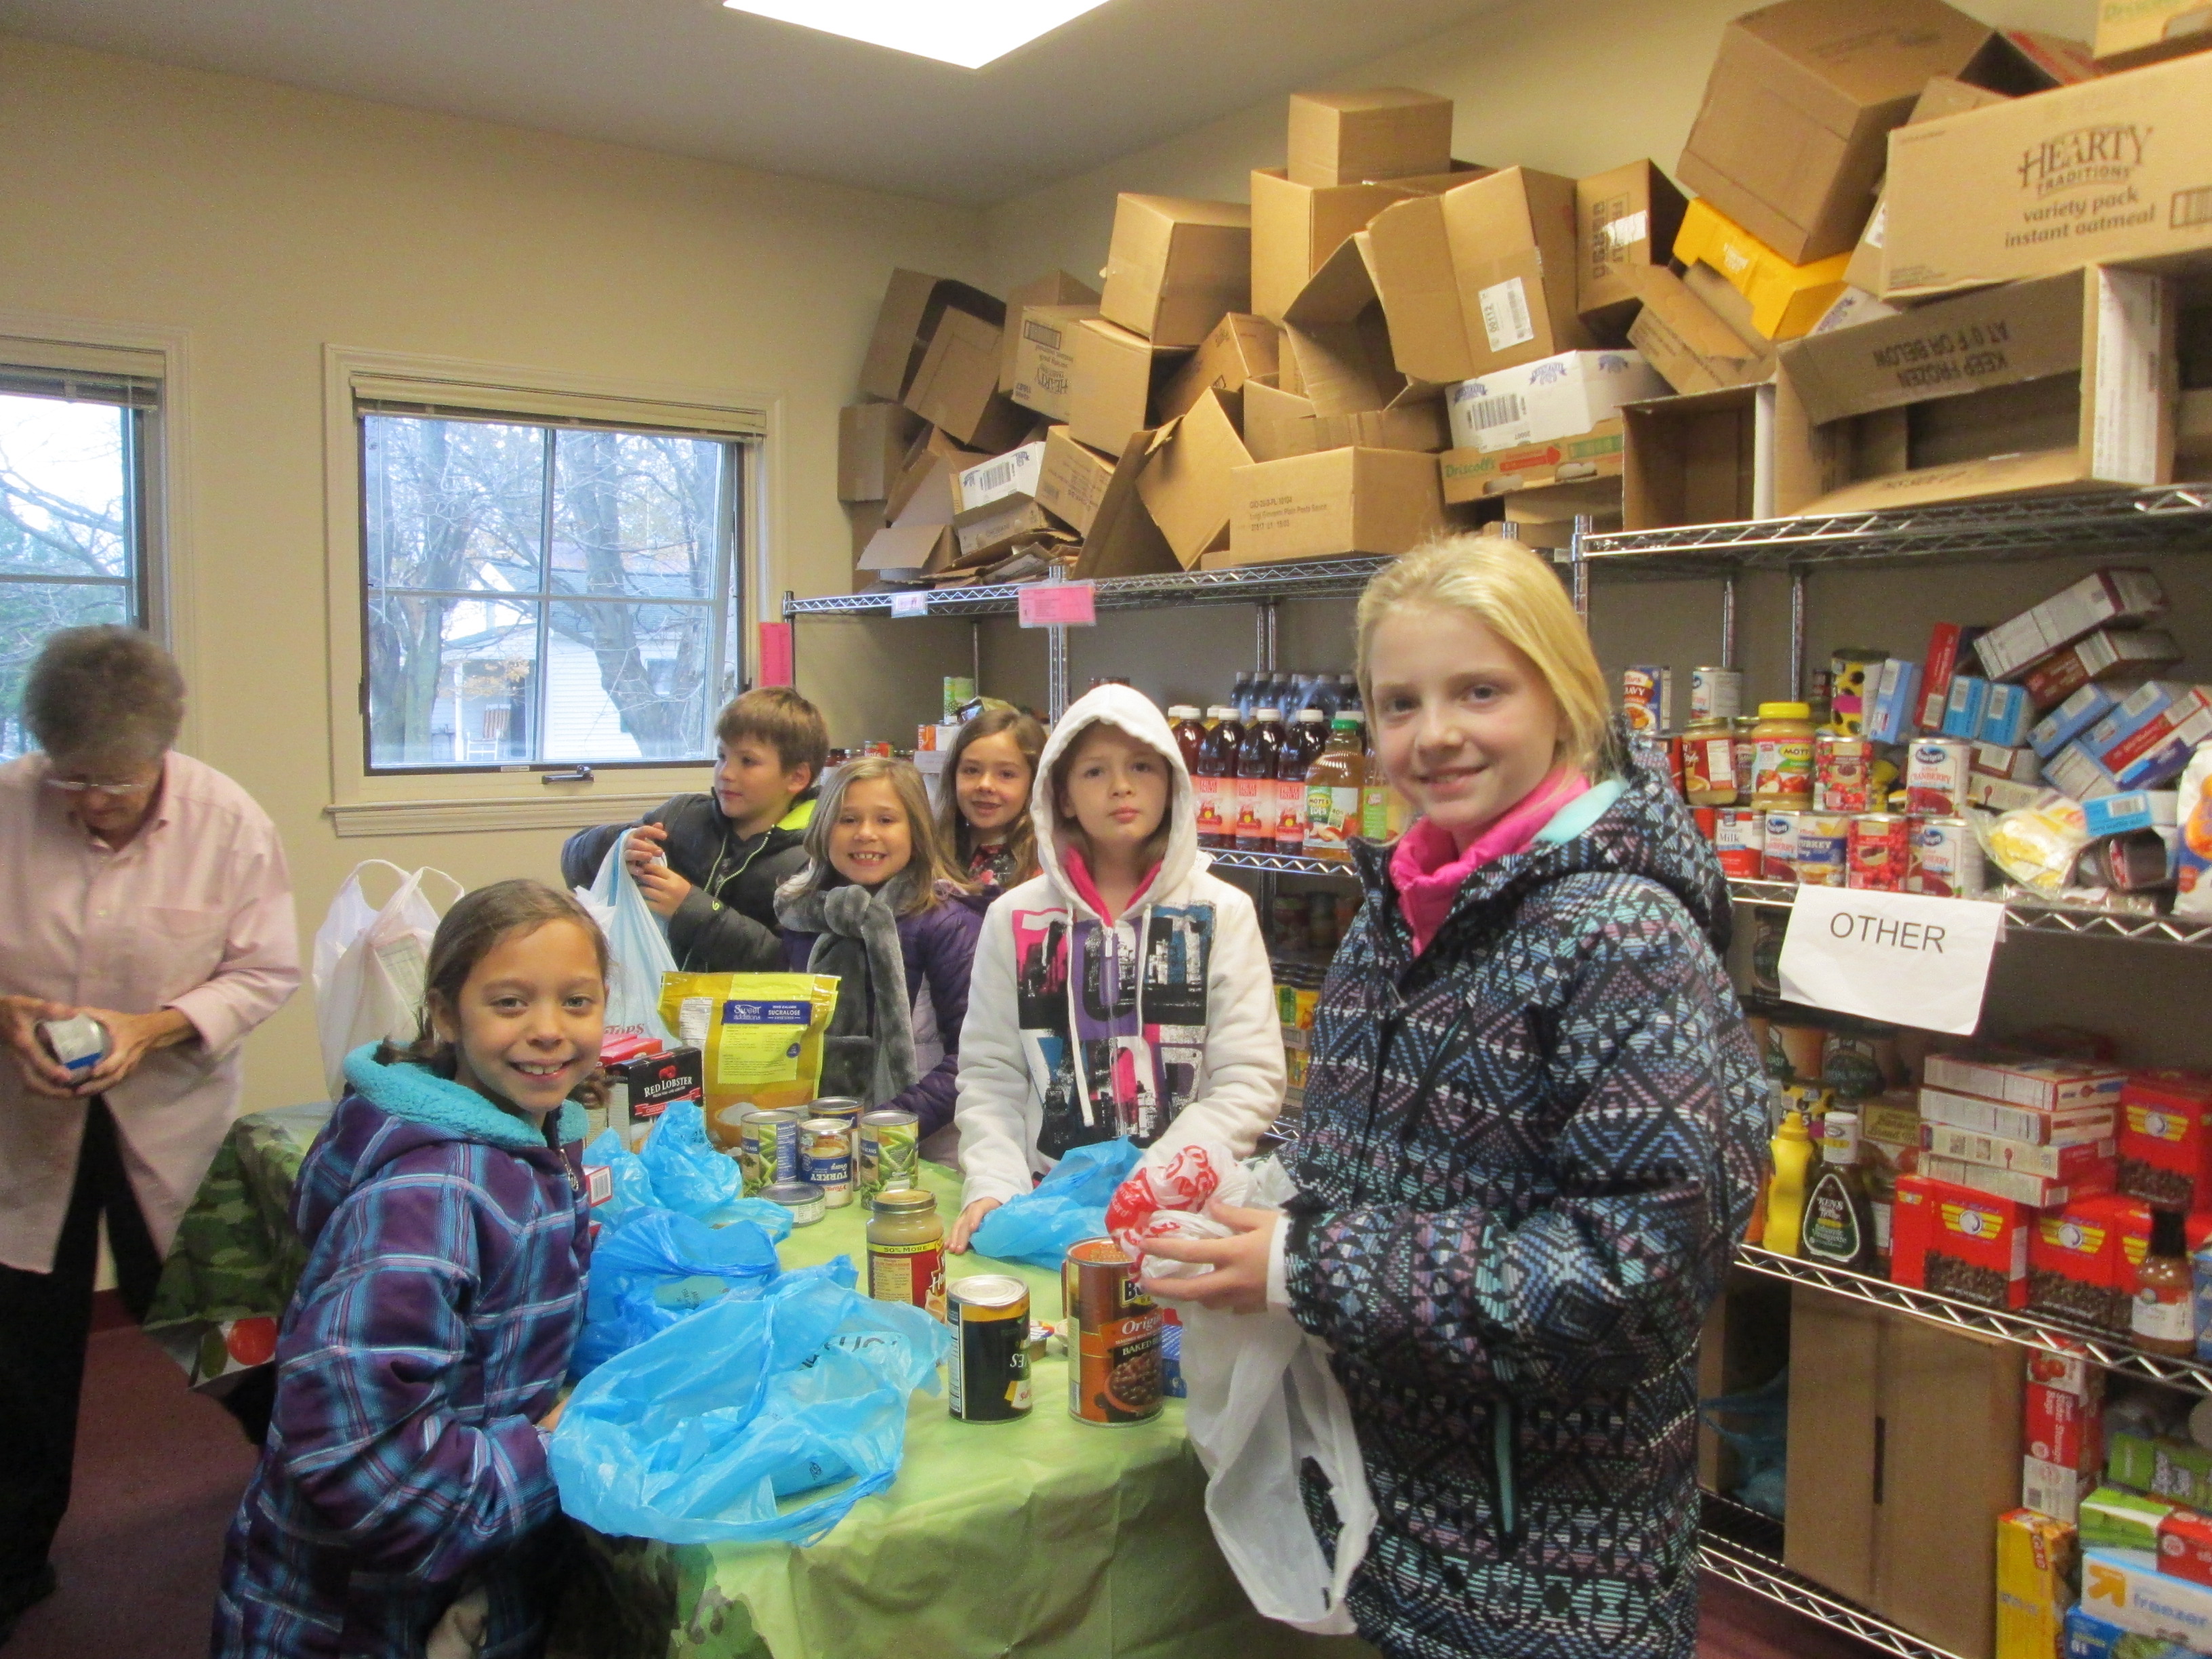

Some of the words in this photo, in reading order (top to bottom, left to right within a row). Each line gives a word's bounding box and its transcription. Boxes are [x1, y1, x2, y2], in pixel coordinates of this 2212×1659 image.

[2017, 125, 2154, 188] HEARTY
[2024, 199, 2087, 223] variety
[2093, 185, 2137, 215] pack
[2005, 223, 2070, 249] instant
[2075, 203, 2156, 236] oatmeal
[1898, 359, 1961, 388] FROZEN
[1965, 350, 2007, 376] KEEP
[1034, 368, 1069, 394] HEARTY
[1719, 834, 1740, 842] Milk
[1830, 912, 1946, 954] OTHER
[734, 1004, 762, 1015] Sweet
[644, 1084, 661, 1097] RED
[661, 1076, 693, 1090] LOBSTER
[811, 1172, 848, 1182] TURKEY
[1122, 1340, 1149, 1355] BAKED
